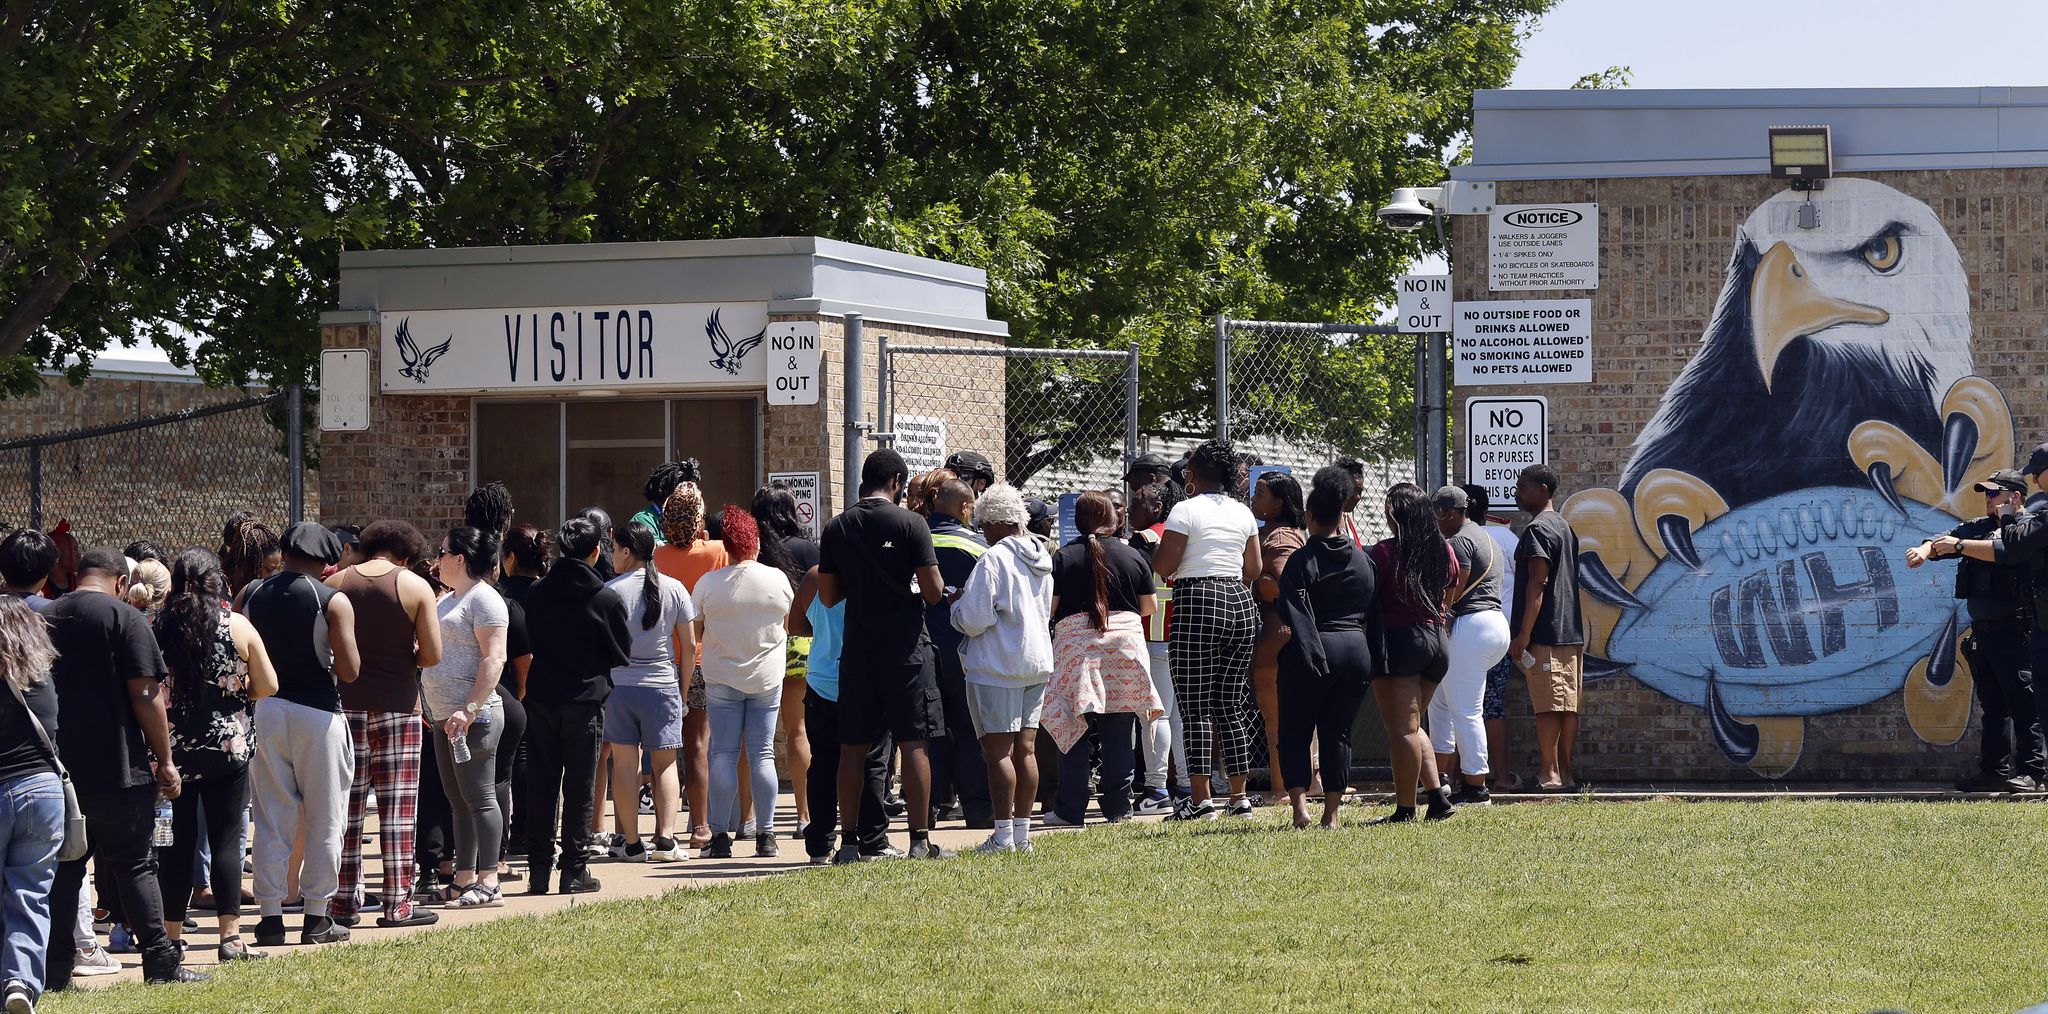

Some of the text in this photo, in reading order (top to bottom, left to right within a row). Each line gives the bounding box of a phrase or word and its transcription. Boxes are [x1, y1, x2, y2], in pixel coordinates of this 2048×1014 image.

[1517, 212, 1568, 224] NOTICE
[1404, 280, 1446, 292] NO IN
[1420, 297, 1430, 310] &
[1464, 309, 1580, 320] NO OUTSIDE FOOD OR
[1408, 315, 1442, 328] OUT
[1475, 323, 1570, 333] DRINKS ALLOWED
[505, 310, 653, 382] VISITOR
[772, 336, 814, 350] NO IN
[1461, 336, 1584, 347] NO ALCOHOL ALLOWED
[1461, 350, 1584, 361] NO SMOKING ALLOWED
[788, 356, 798, 370] &
[1473, 364, 1572, 374] NO PETS ALLOWED
[776, 376, 810, 390] OUT
[1490, 410, 1523, 428] NO
[1475, 434, 1538, 446] BACKPACKS
[1480, 451, 1534, 463] OR PURSES
[1486, 469, 1522, 480] BEYON
[1711, 546, 1899, 669] WH
